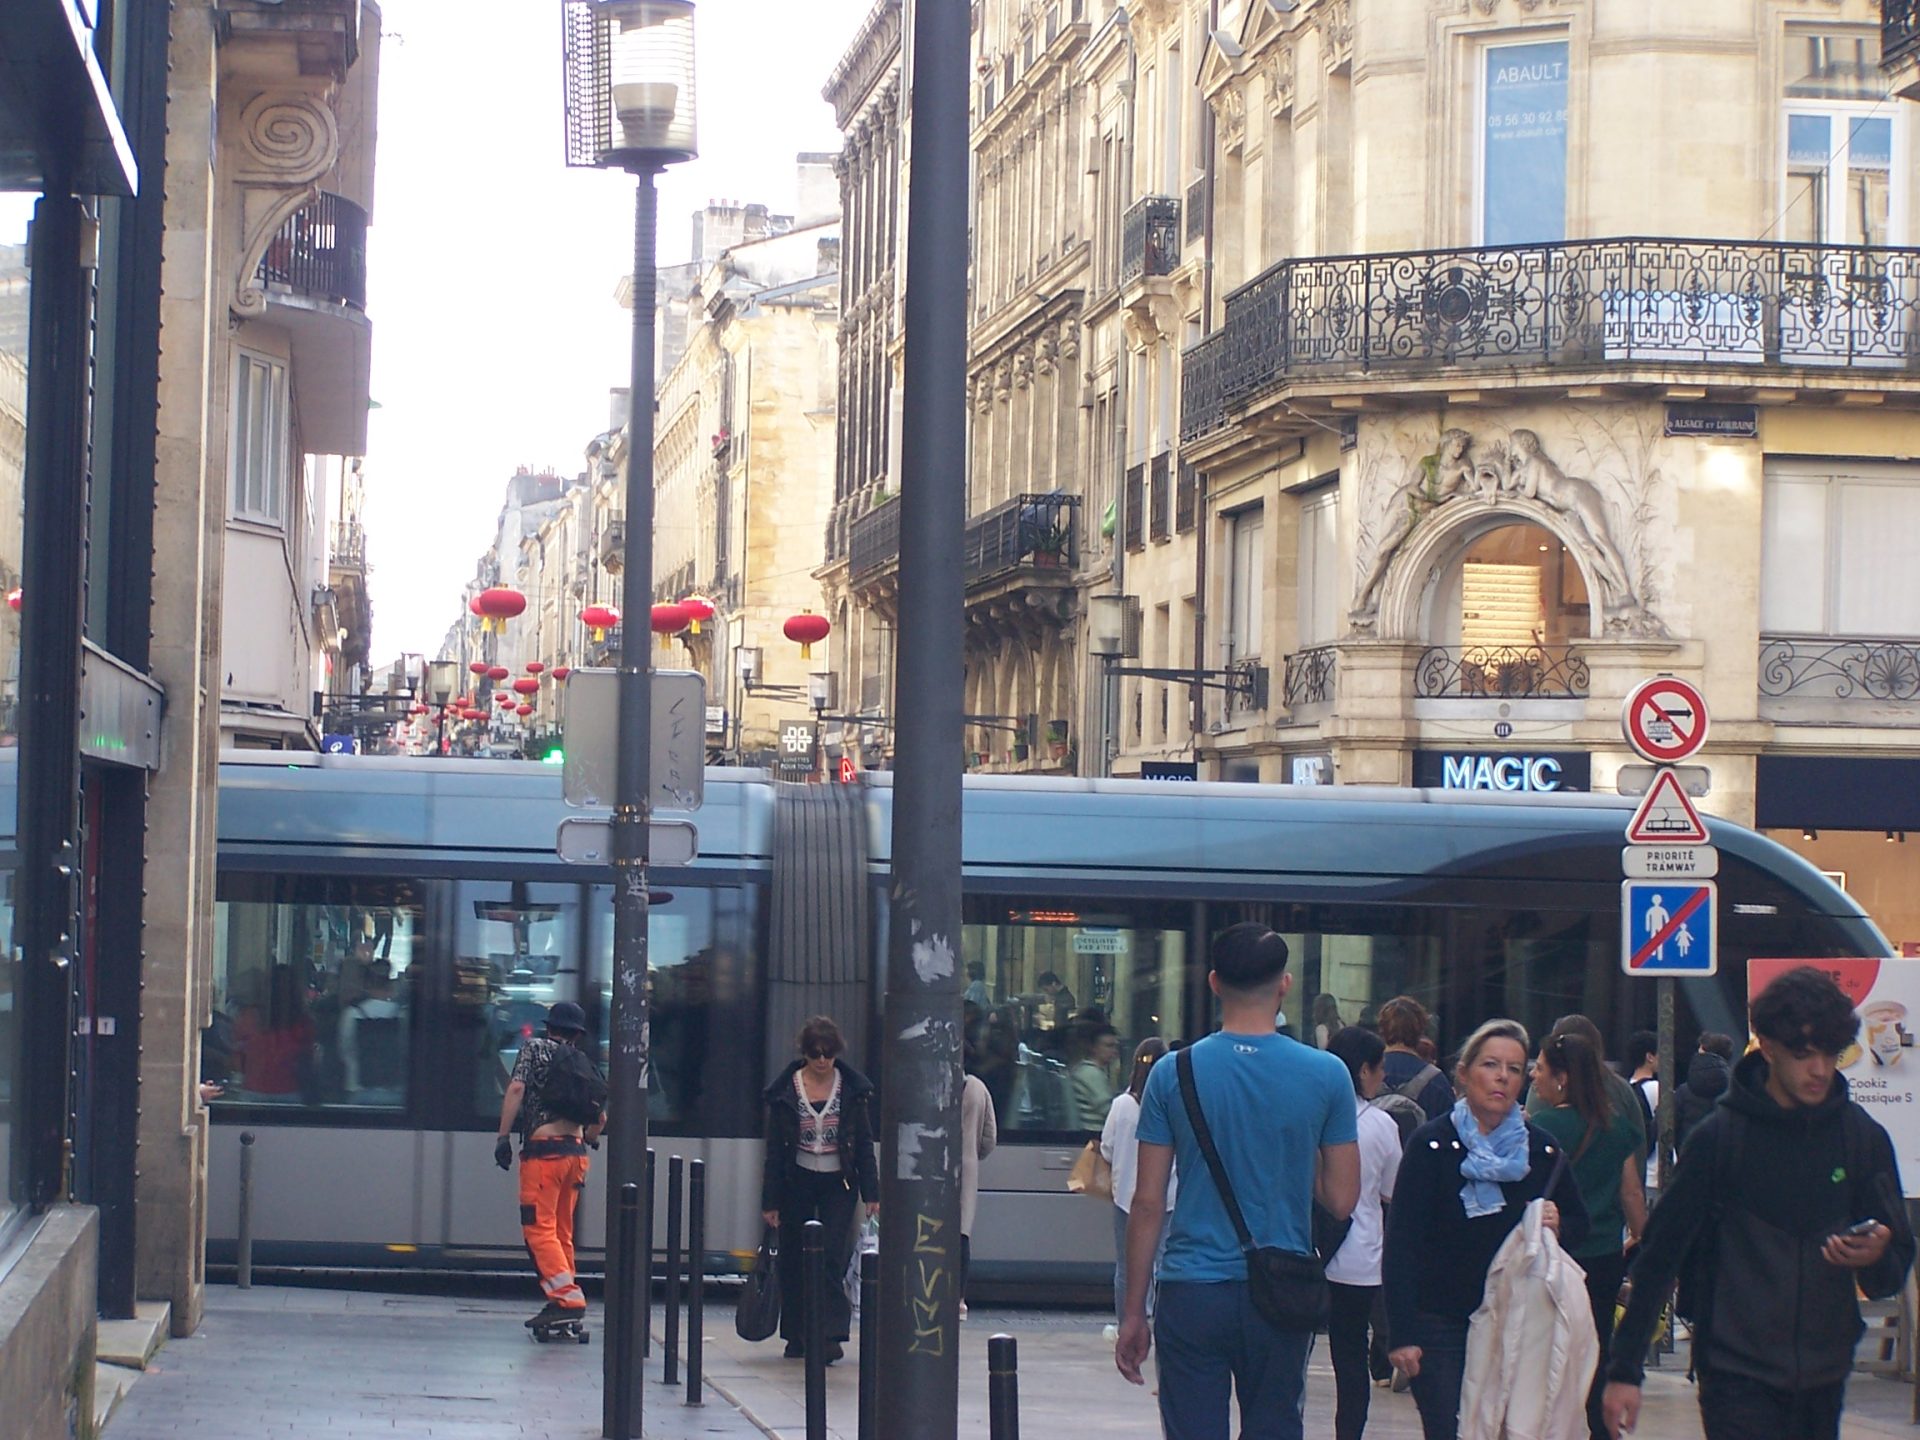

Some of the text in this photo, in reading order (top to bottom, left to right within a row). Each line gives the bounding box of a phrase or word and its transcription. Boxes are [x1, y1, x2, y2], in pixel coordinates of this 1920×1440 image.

[1496, 62, 1563, 84] ABAULT
[1716, 421, 1754, 430] LORRAINE
[1443, 756, 1562, 791] MAGIC
[1647, 850, 1695, 860] PRIORITÉ
[1646, 863, 1696, 872] TRAMWAY
[1849, 1078, 1888, 1089] Cookiz
[1905, 1093, 1913, 1103] S
